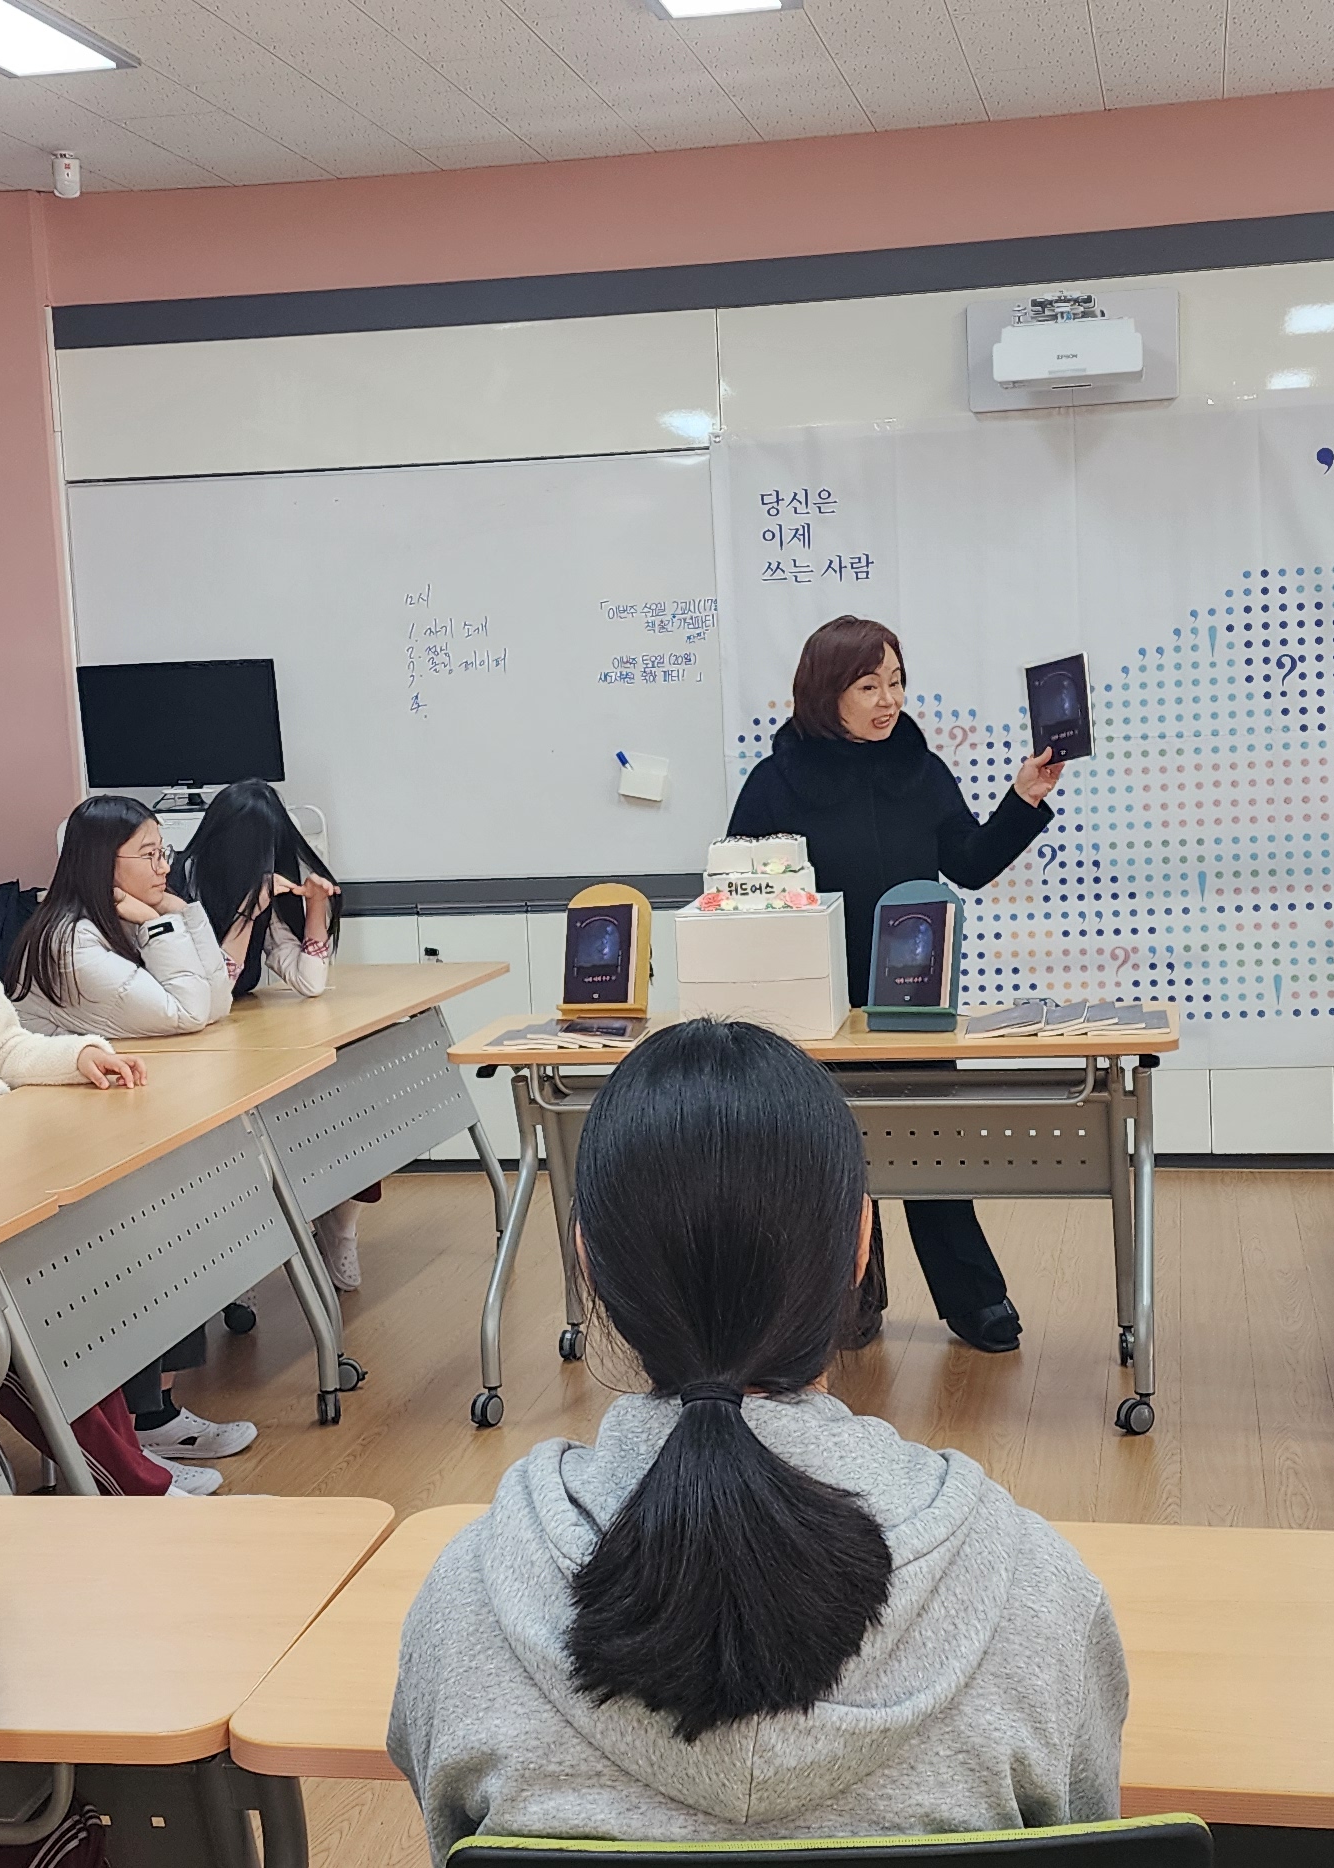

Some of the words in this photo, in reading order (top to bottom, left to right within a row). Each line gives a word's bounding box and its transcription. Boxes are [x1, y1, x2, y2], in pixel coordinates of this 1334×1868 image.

[759, 488, 838, 517] 당신은
[762, 522, 811, 551] 이제
[761, 558, 814, 584] 쓰는
[821, 552, 875, 583] 사람
[727, 881, 776, 896] 위드어스
